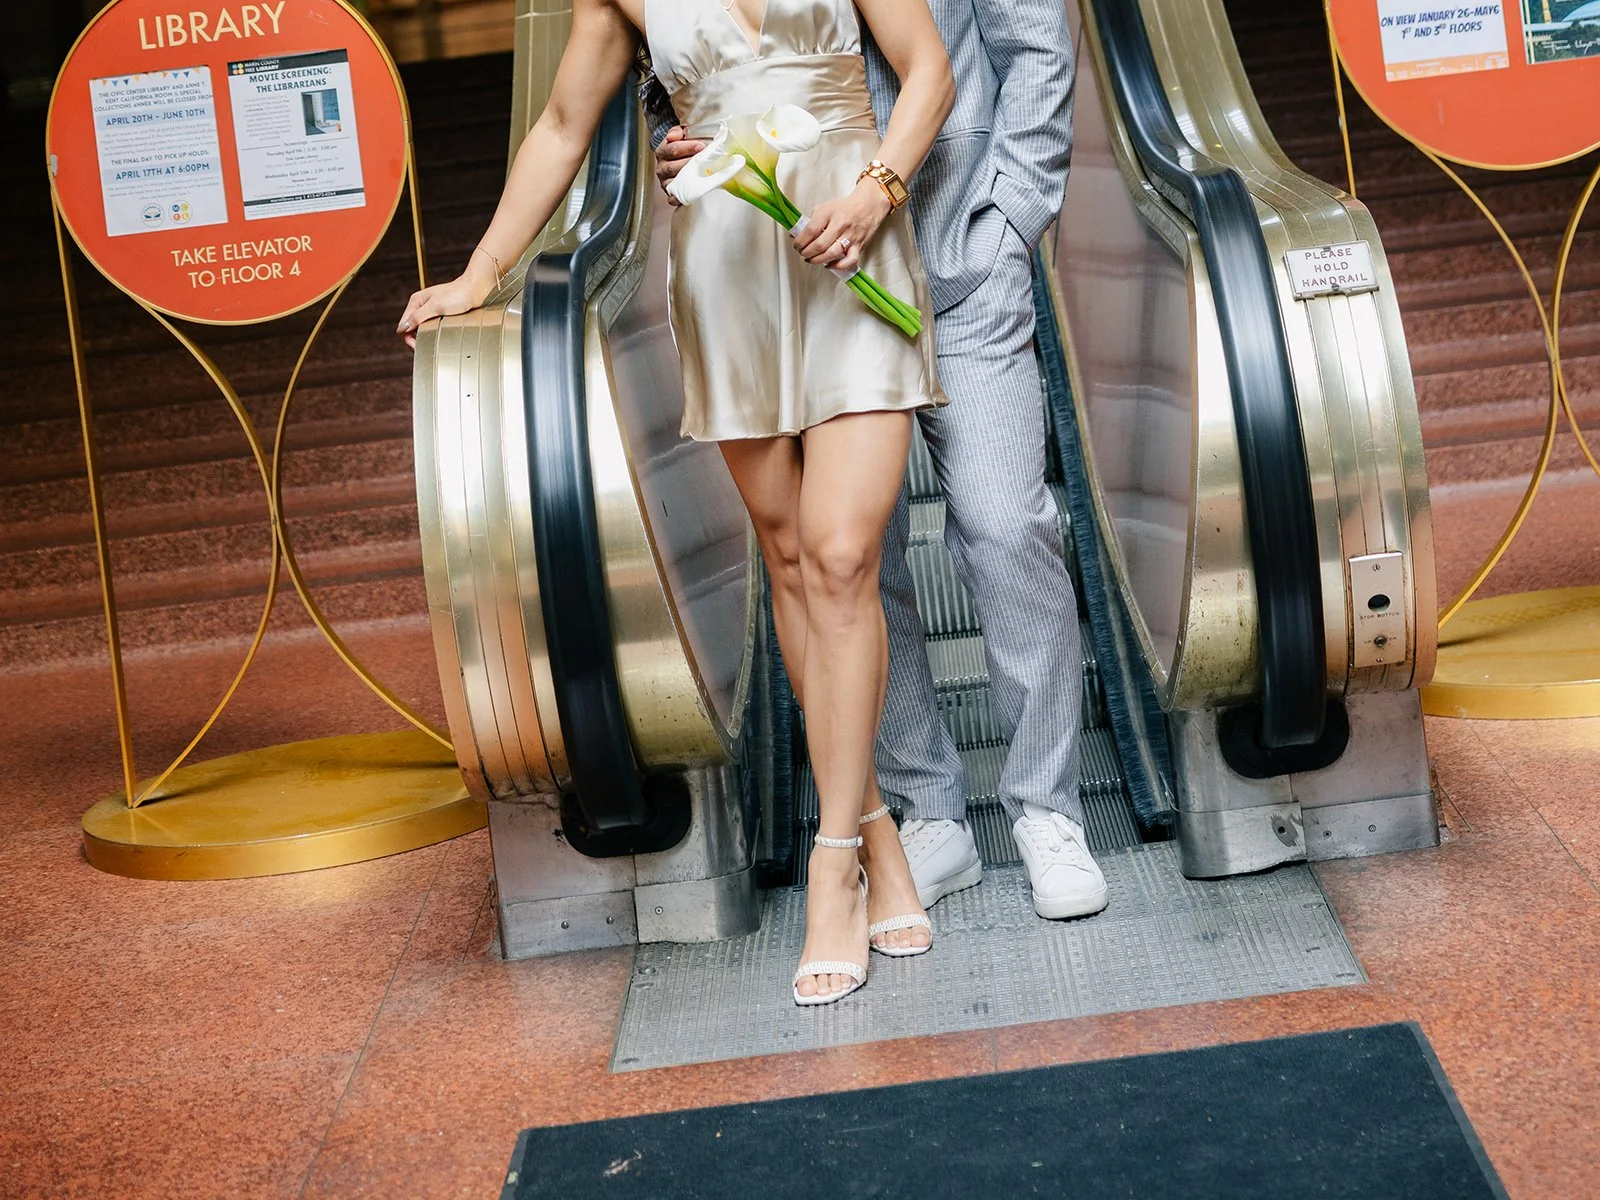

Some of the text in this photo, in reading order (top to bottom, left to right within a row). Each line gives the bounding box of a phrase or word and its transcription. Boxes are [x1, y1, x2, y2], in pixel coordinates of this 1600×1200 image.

[138, 1, 286, 50] LIBRARY
[1381, 16, 1394, 27] ON
[1396, 14, 1416, 26] VIEW
[1418, 10, 1455, 23] JANUARY
[1414, 26, 1432, 38] AND
[1449, 21, 1482, 34] FLOORS
[250, 67, 332, 83] MOVIE SCREENING:
[147, 85, 170, 93] LIBRARY
[256, 78, 326, 93] THE LIBRARIANS
[121, 94, 153, 103] CALIFORNIA
[94, 103, 132, 112] COLLECTIONS
[106, 116, 130, 126] APRIL
[132, 114, 153, 123] 20TH
[162, 110, 182, 120] JUNE
[186, 108, 205, 117] 10TH
[116, 162, 209, 180] APRIL 17TH AT 6:00PM
[171, 234, 312, 267] TAKE ELEVATOR
[1304, 248, 1352, 260] PLEASE
[188, 260, 302, 288] TO FLOOR 4
[1314, 261, 1349, 273] HOLD
[1302, 273, 1368, 287] HANDRAIL
